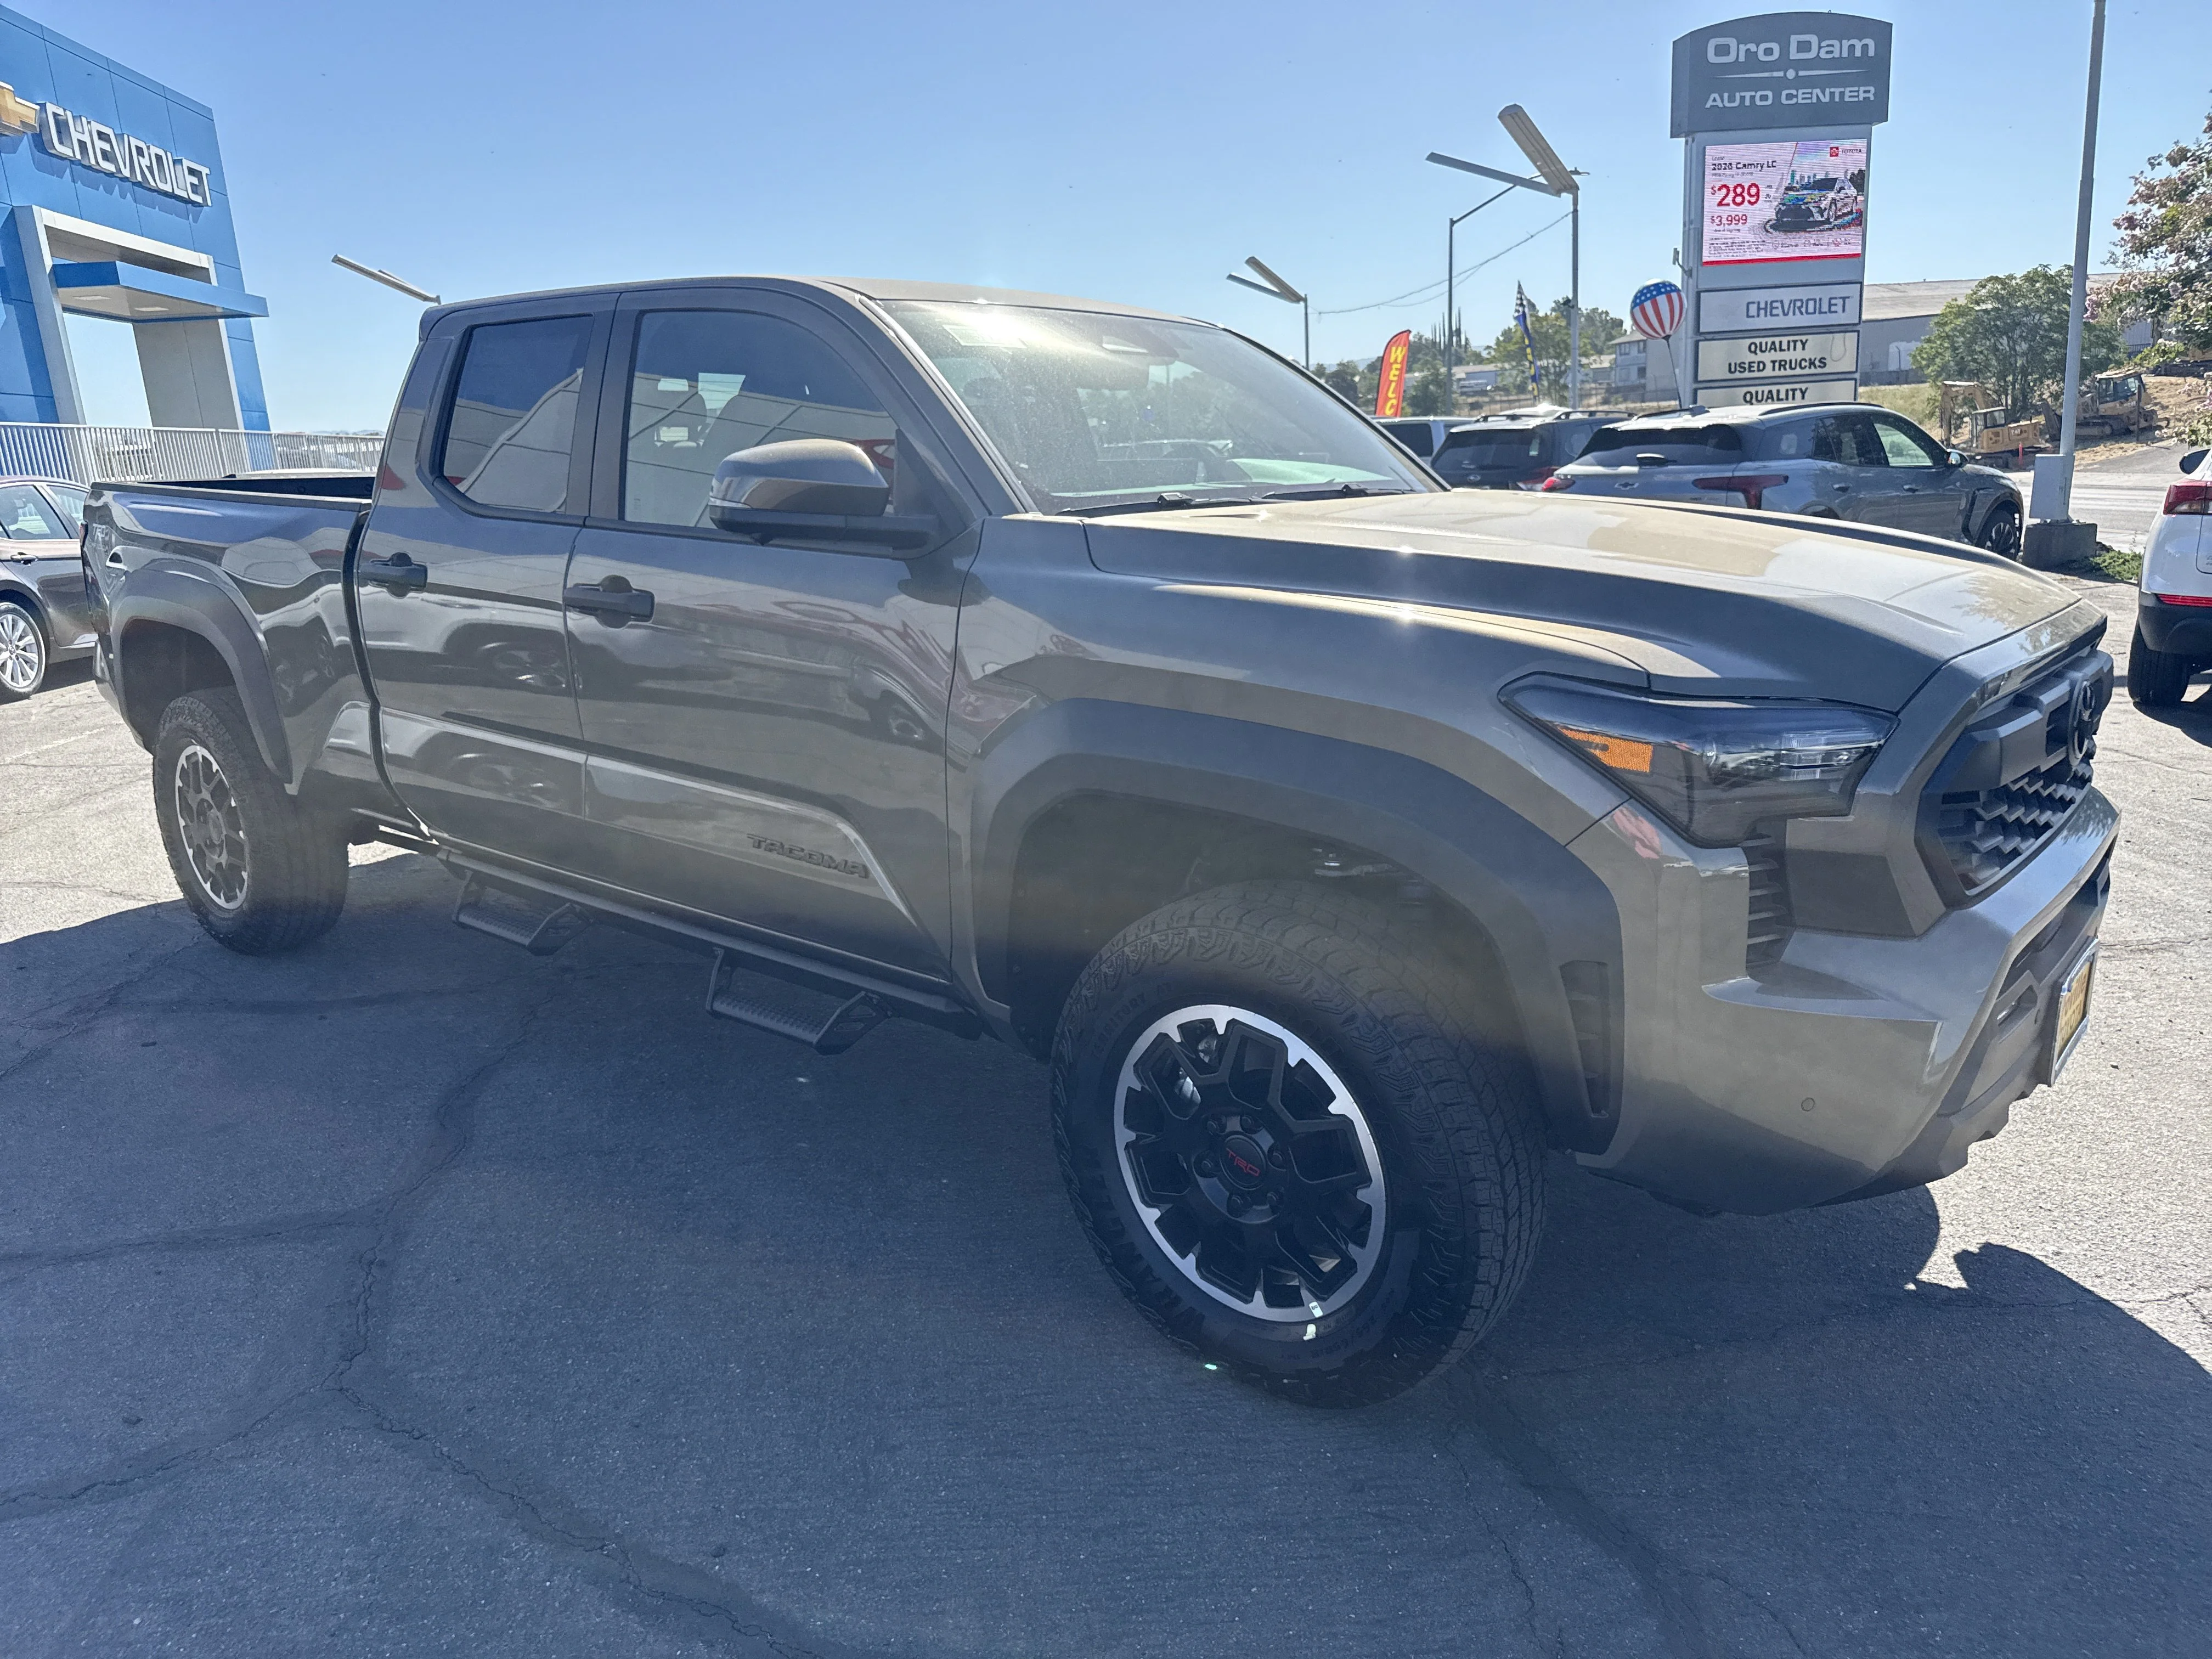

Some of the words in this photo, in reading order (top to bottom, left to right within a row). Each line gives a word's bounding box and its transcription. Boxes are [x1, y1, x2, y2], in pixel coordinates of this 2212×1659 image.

[1707, 37, 1780, 64] Oro
[1790, 33, 1876, 60] Dam
[1705, 90, 1773, 109] AUTO
[1781, 86, 1876, 105] CENTER
[44, 101, 212, 207] CHEVROLET
[1735, 162, 1765, 172] Camry
[1711, 183, 1760, 207] $289
[1710, 214, 1747, 227] $3,999
[1745, 296, 1850, 319] CHEVROLET
[1747, 338, 1809, 356] QUALITY
[1728, 361, 1766, 374] USED
[1770, 357, 1827, 371] TRUCKS
[1742, 387, 1809, 405] QUALITY
[746, 833, 870, 879] TACOMA
[1226, 1147, 1260, 1177] TRD
